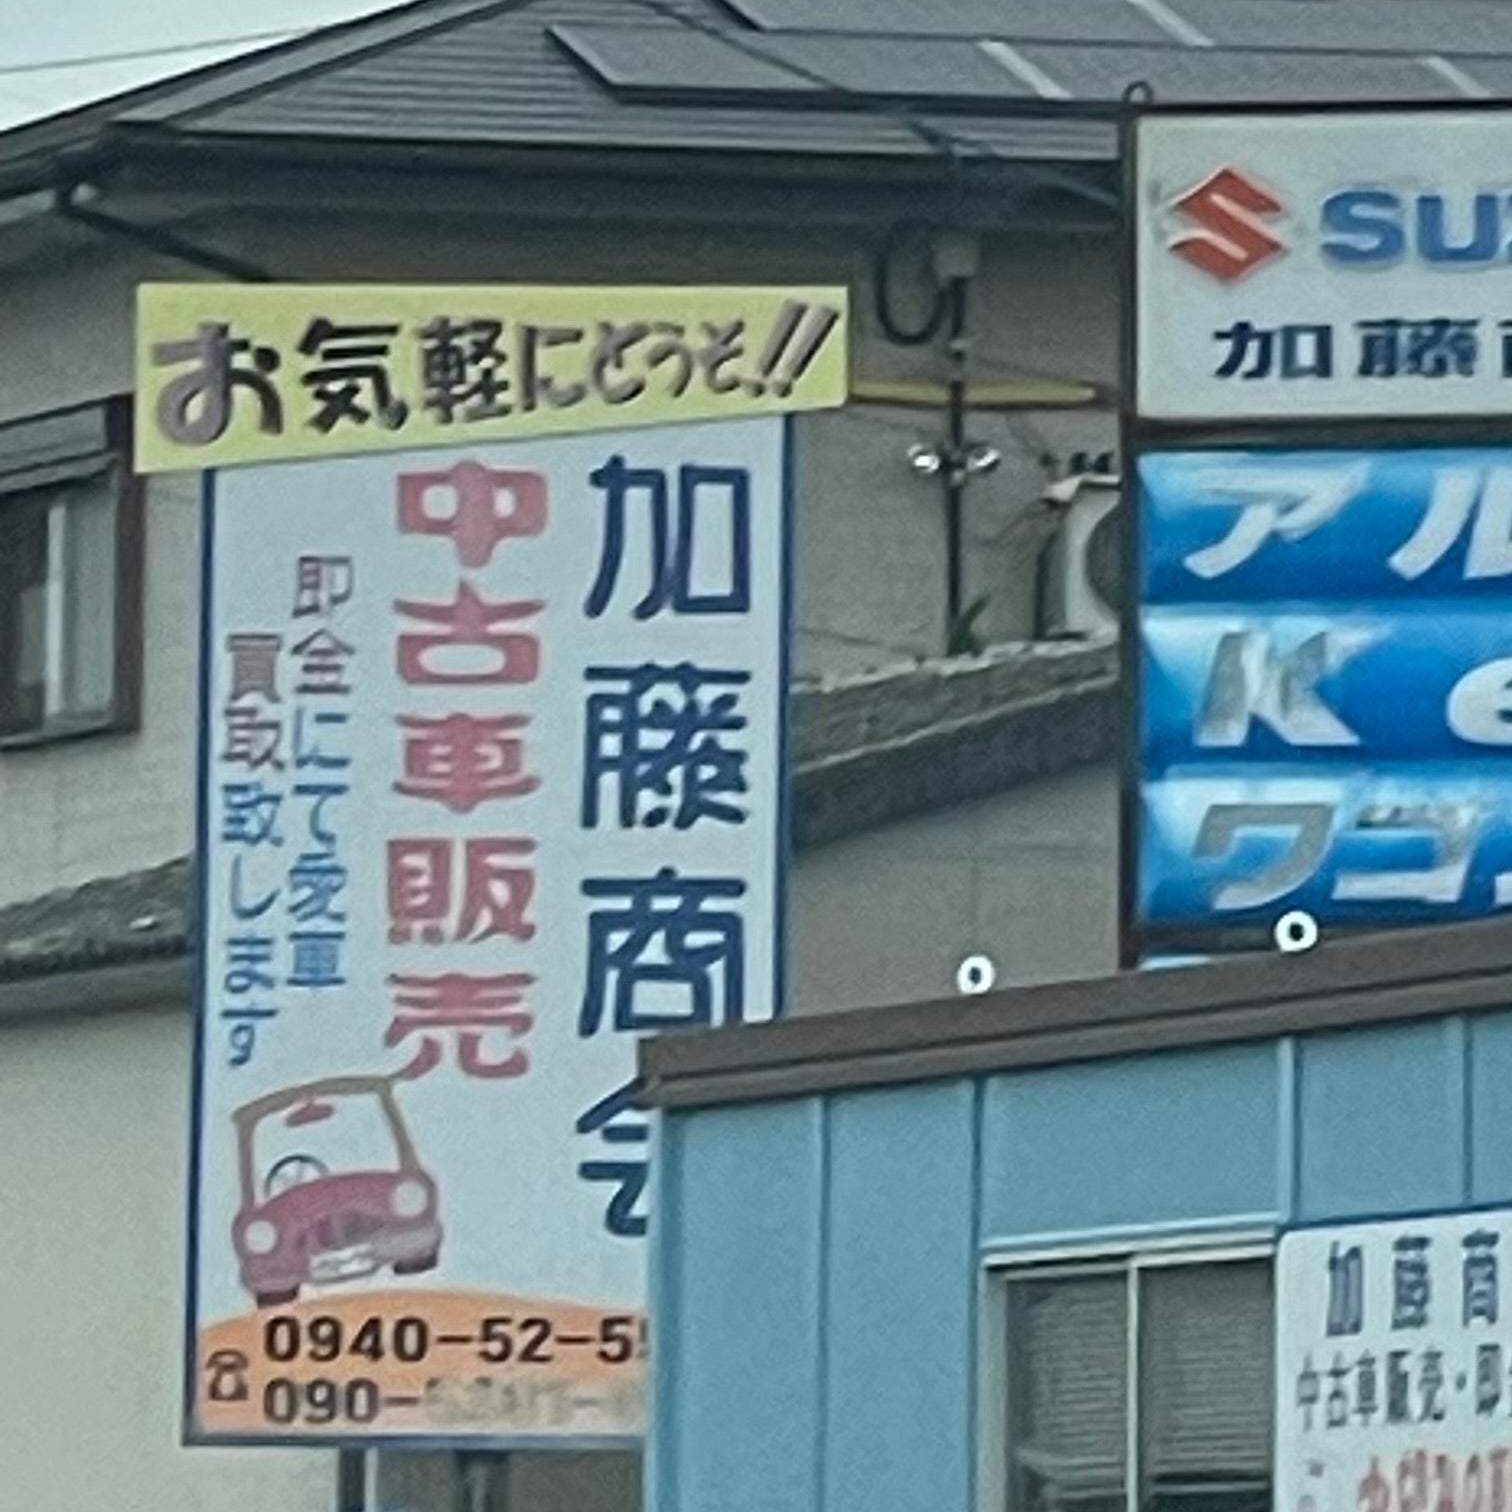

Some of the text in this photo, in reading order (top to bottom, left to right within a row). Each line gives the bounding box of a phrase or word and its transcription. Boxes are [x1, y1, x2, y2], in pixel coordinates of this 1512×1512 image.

[383, 460, 549, 1080] 中古車販売
[263, 1315, 648, 1364] 0940-52-5
